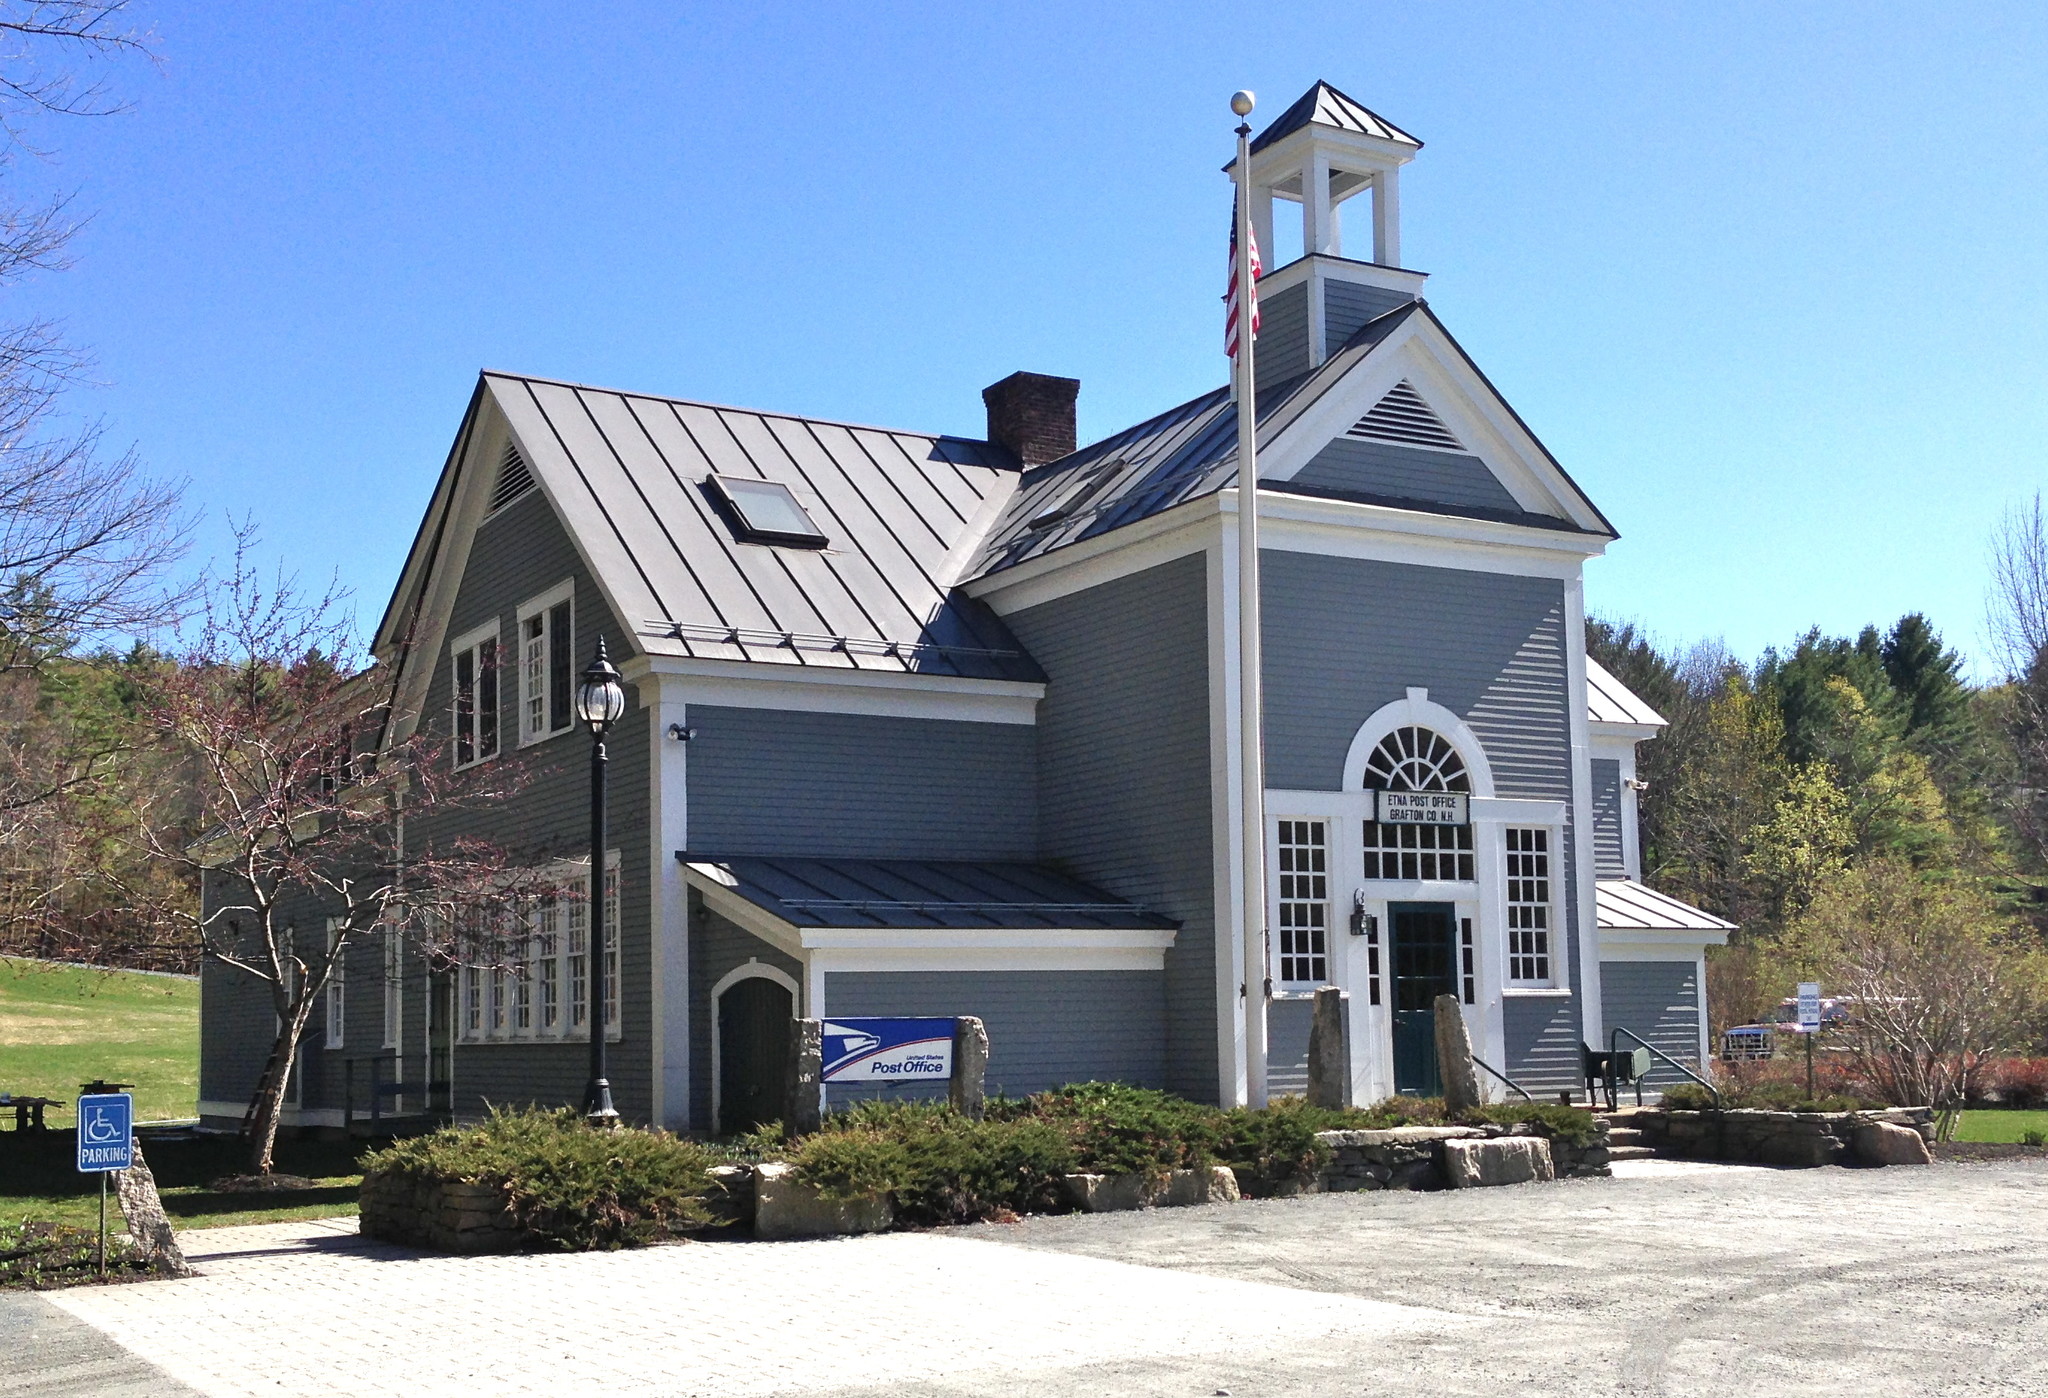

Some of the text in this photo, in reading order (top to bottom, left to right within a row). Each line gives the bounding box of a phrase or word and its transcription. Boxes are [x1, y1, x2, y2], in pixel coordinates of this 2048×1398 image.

[1388, 795, 1456, 808] ETNA POST OFFICE
[1390, 809, 1424, 821] GRAFTON
[1441, 811, 1454, 822] N.H.
[871, 1061, 943, 1074] Post Office
[81, 1147, 127, 1164] PARKING
